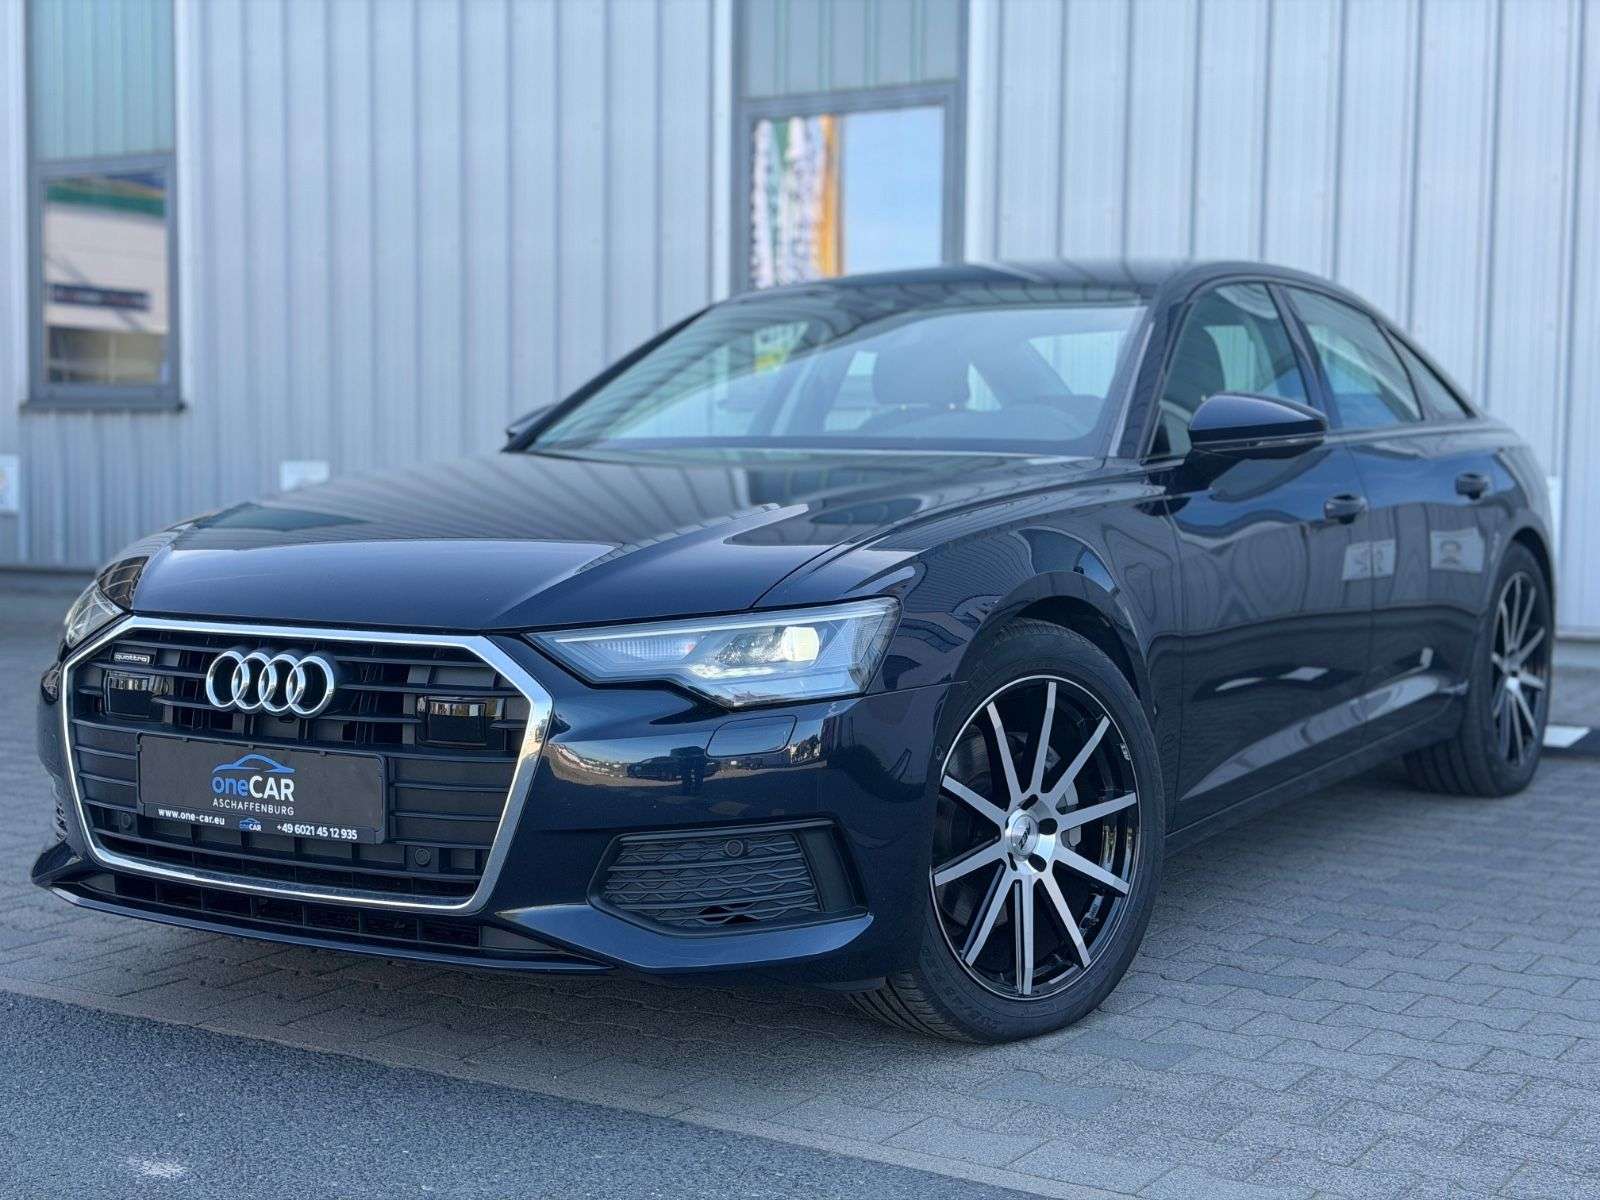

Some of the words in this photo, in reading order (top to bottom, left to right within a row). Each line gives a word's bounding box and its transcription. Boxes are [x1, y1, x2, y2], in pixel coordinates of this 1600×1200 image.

[211, 775, 296, 802] oneCAR
[212, 797, 295, 816] ASCHAFFENBURG
[157, 808, 226, 826] www.one-car.eu
[276, 822, 294, 834] +49
[294, 824, 316, 836] 6021
[316, 826, 329, 837] 45
[329, 827, 340, 838] 12
[340, 828, 358, 840] 935
